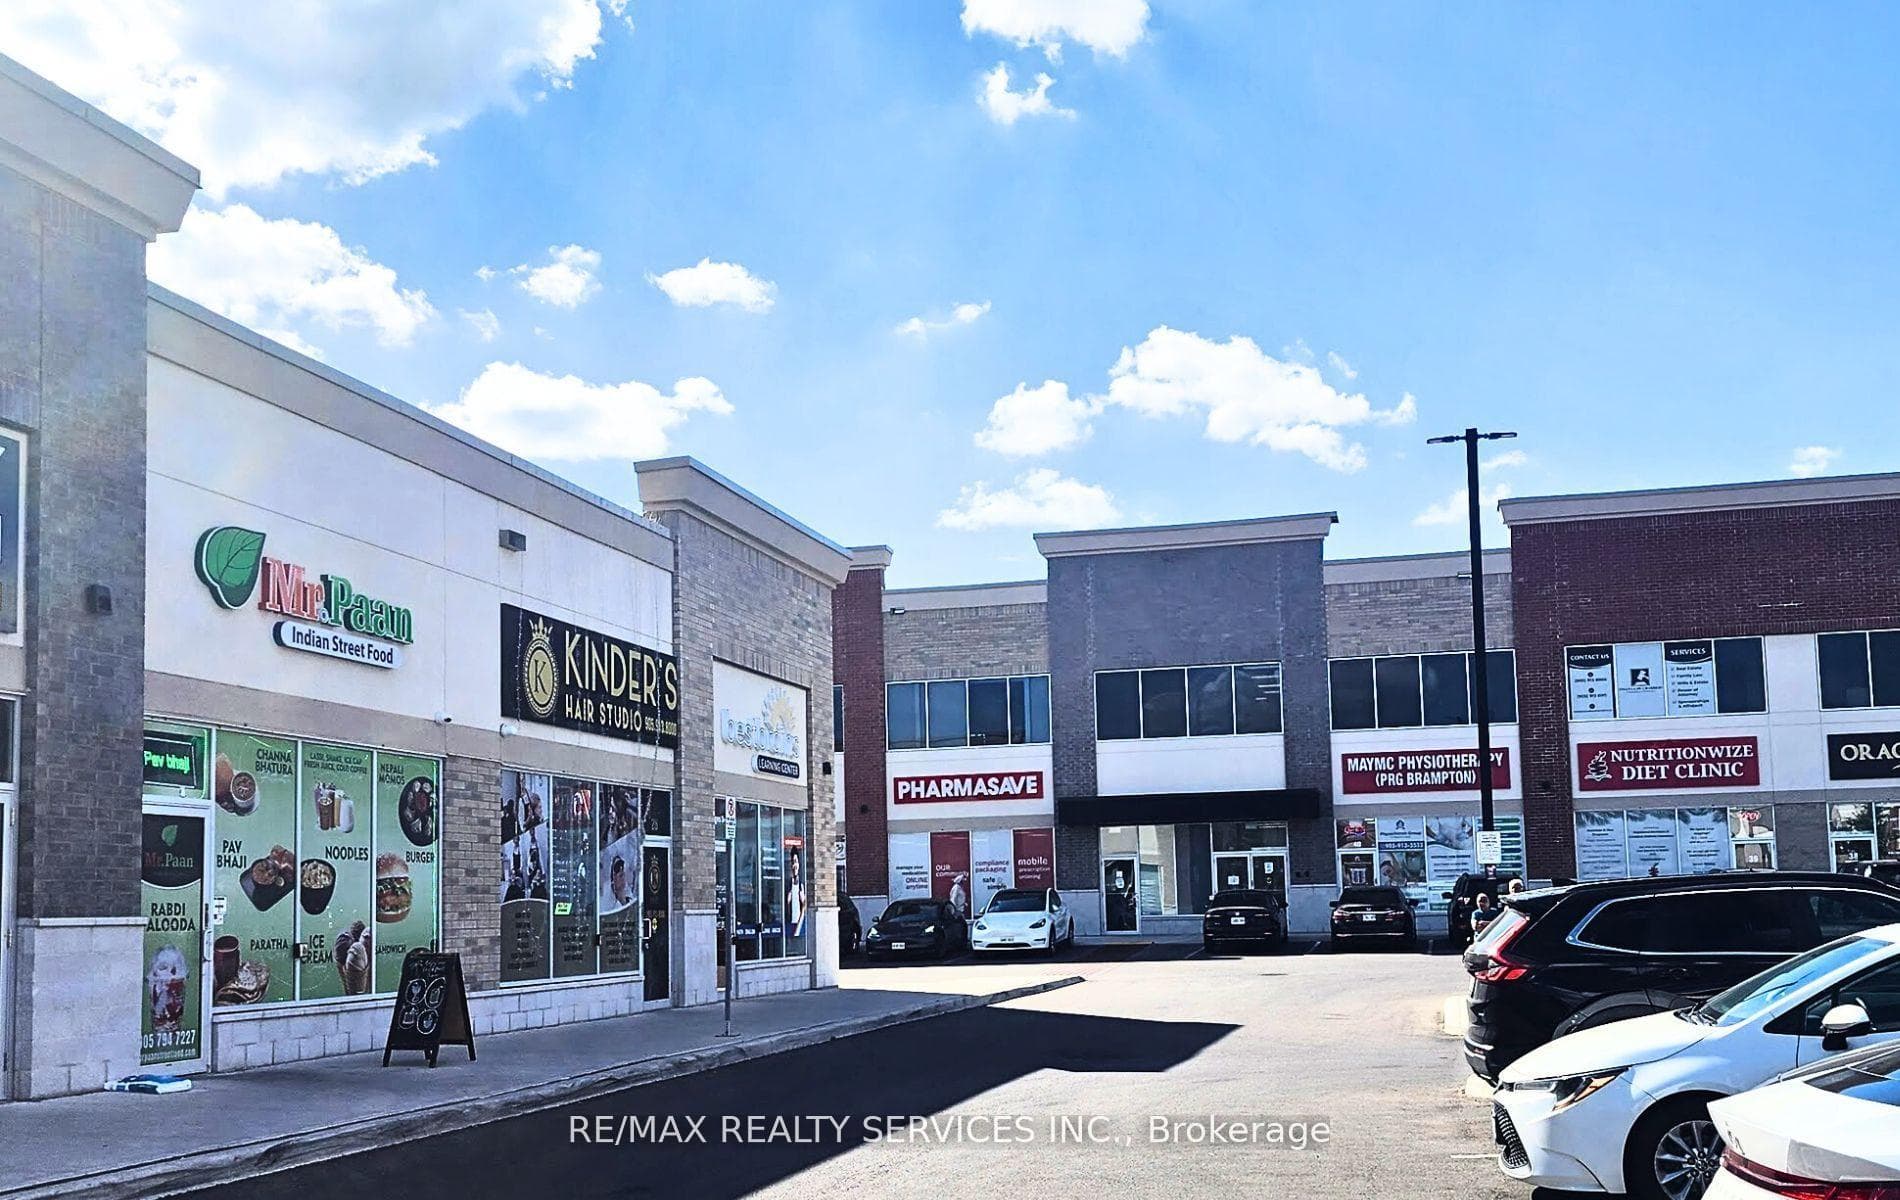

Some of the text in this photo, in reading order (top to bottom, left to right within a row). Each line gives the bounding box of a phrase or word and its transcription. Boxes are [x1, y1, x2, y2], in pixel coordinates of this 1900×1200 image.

[292, 625, 394, 664] Indian Street Food
[1670, 647, 1706, 656] SERVICES
[565, 629, 678, 711] KINDER'S
[565, 694, 642, 732] HAIR STUDIO
[256, 748, 292, 763] CHANNA
[1611, 744, 1754, 763] NUTRITIONWIZE
[255, 761, 293, 776] BHATURA
[380, 763, 404, 775] NEPALI
[759, 758, 799, 776] LEARNING CENTER
[1347, 757, 1395, 772] MAYMC
[1622, 761, 1744, 781] DIET CLINIC
[379, 774, 405, 785] MOMOS
[1375, 769, 1477, 787] (PRG BRAMPTON)
[897, 775, 1038, 800] PHARMASAVE
[222, 840, 242, 854] PAV
[325, 846, 369, 861] NOODLES
[216, 854, 247, 869] BHAJI
[405, 850, 435, 864] BURGER
[1017, 856, 1049, 866] mobile
[151, 902, 186, 917] RABDI
[251, 938, 289, 950] PARATHA
[309, 934, 325, 949] ICE
[175, 1029, 196, 1046] 7227
